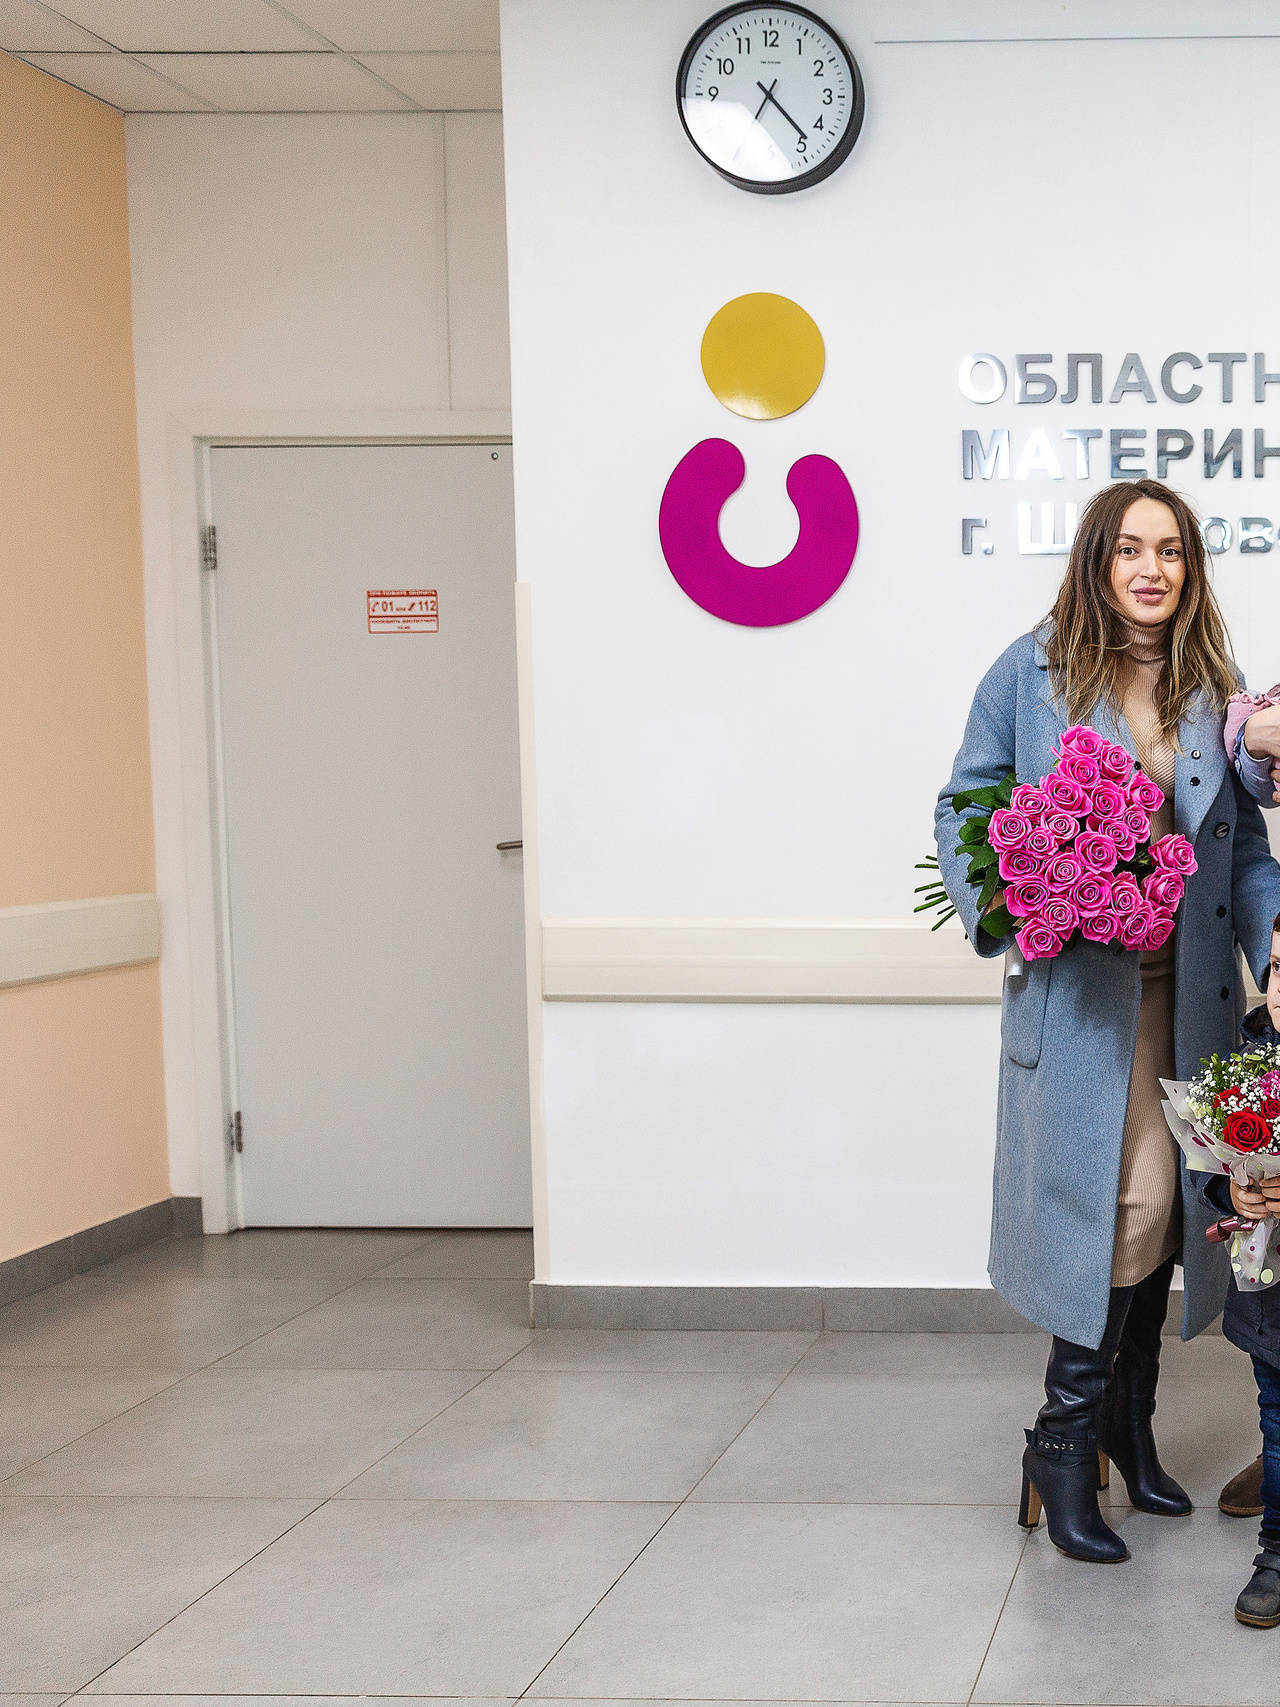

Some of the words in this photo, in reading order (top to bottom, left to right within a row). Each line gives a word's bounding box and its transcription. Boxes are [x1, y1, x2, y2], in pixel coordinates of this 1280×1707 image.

[736, 37, 750, 54] 11
[762, 30, 780, 48] 12
[796, 38, 802, 55] 1
[716, 57, 735, 76] 10
[813, 59, 824, 77] 2
[708, 85, 719, 102] 9
[822, 88, 833, 106] 3
[813, 114, 824, 131] 4
[796, 136, 807, 153] 5
[961, 517, 994, 556] г.
[381, 600, 394, 612] 01
[418, 600, 437, 611] 112
